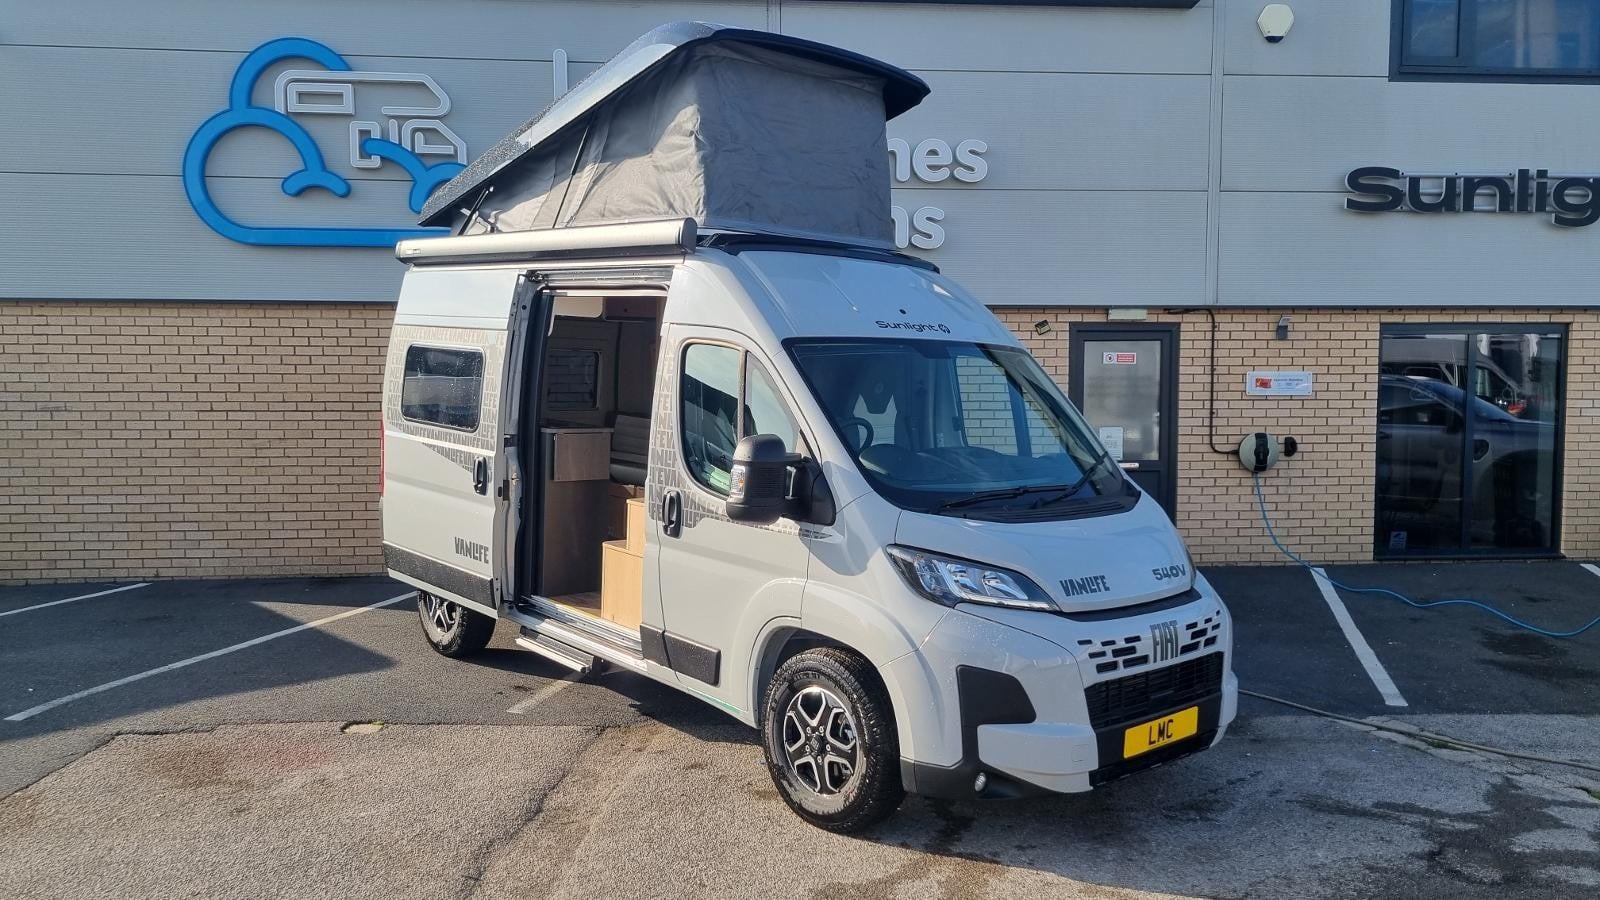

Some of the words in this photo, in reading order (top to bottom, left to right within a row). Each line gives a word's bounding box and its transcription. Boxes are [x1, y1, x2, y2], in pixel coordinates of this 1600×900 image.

[1345, 166, 1600, 228] Sunlig
[875, 320, 939, 333] Sunlight
[454, 536, 489, 564] VANLIFE
[1059, 575, 1111, 597] VANLIFE
[1152, 564, 1187, 581] 540V
[1150, 619, 1180, 664] FIAT
[1148, 718, 1175, 746] LMC
